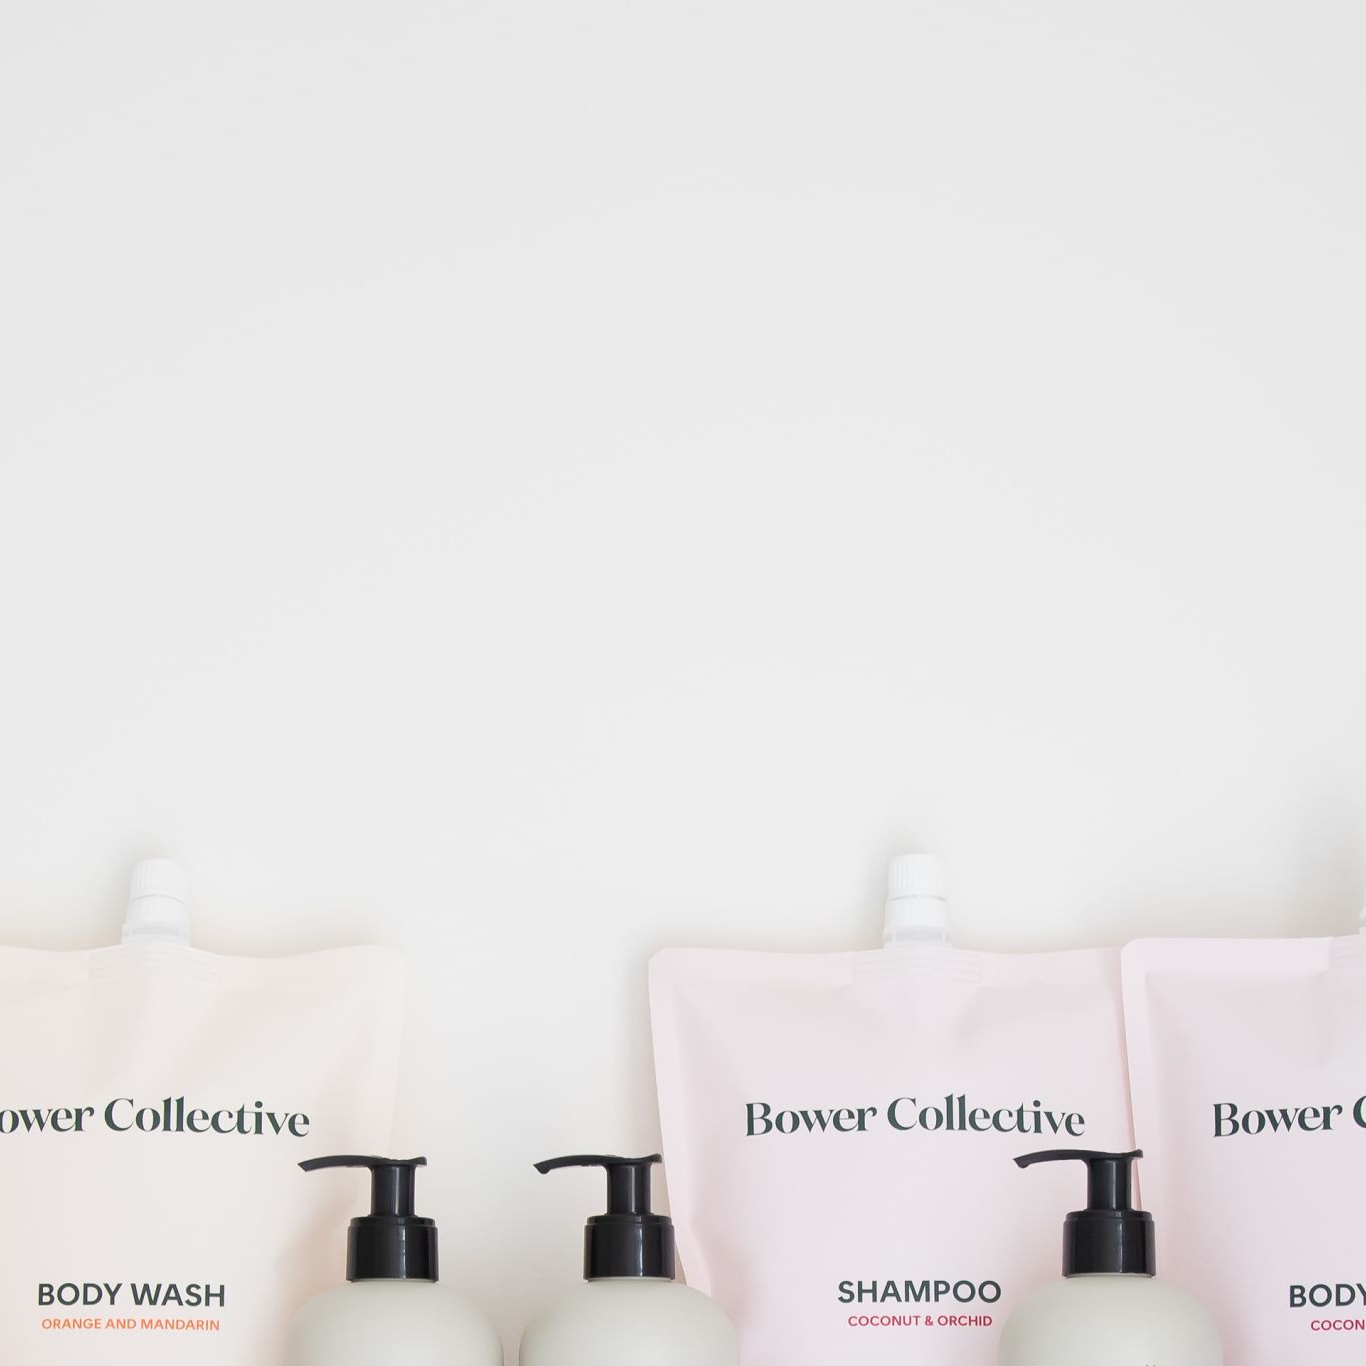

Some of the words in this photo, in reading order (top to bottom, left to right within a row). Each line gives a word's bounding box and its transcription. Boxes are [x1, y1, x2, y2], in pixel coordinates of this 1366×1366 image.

[104, 1096, 309, 1137] Collective
[746, 1103, 877, 1136] Bower
[887, 1093, 1085, 1136] Collective
[1214, 1103, 1343, 1137] Bower
[38, 1283, 122, 1306] BODY
[131, 1283, 225, 1307] WASH
[838, 1280, 1001, 1303] SHAMPOO
[42, 1318, 101, 1329] ORANGE
[105, 1318, 136, 1329] AND
[141, 1318, 219, 1331] MANDARIN
[848, 1315, 921, 1326] COCONUT
[925, 1315, 933, 1326] &
[937, 1315, 993, 1327] ORCHID
